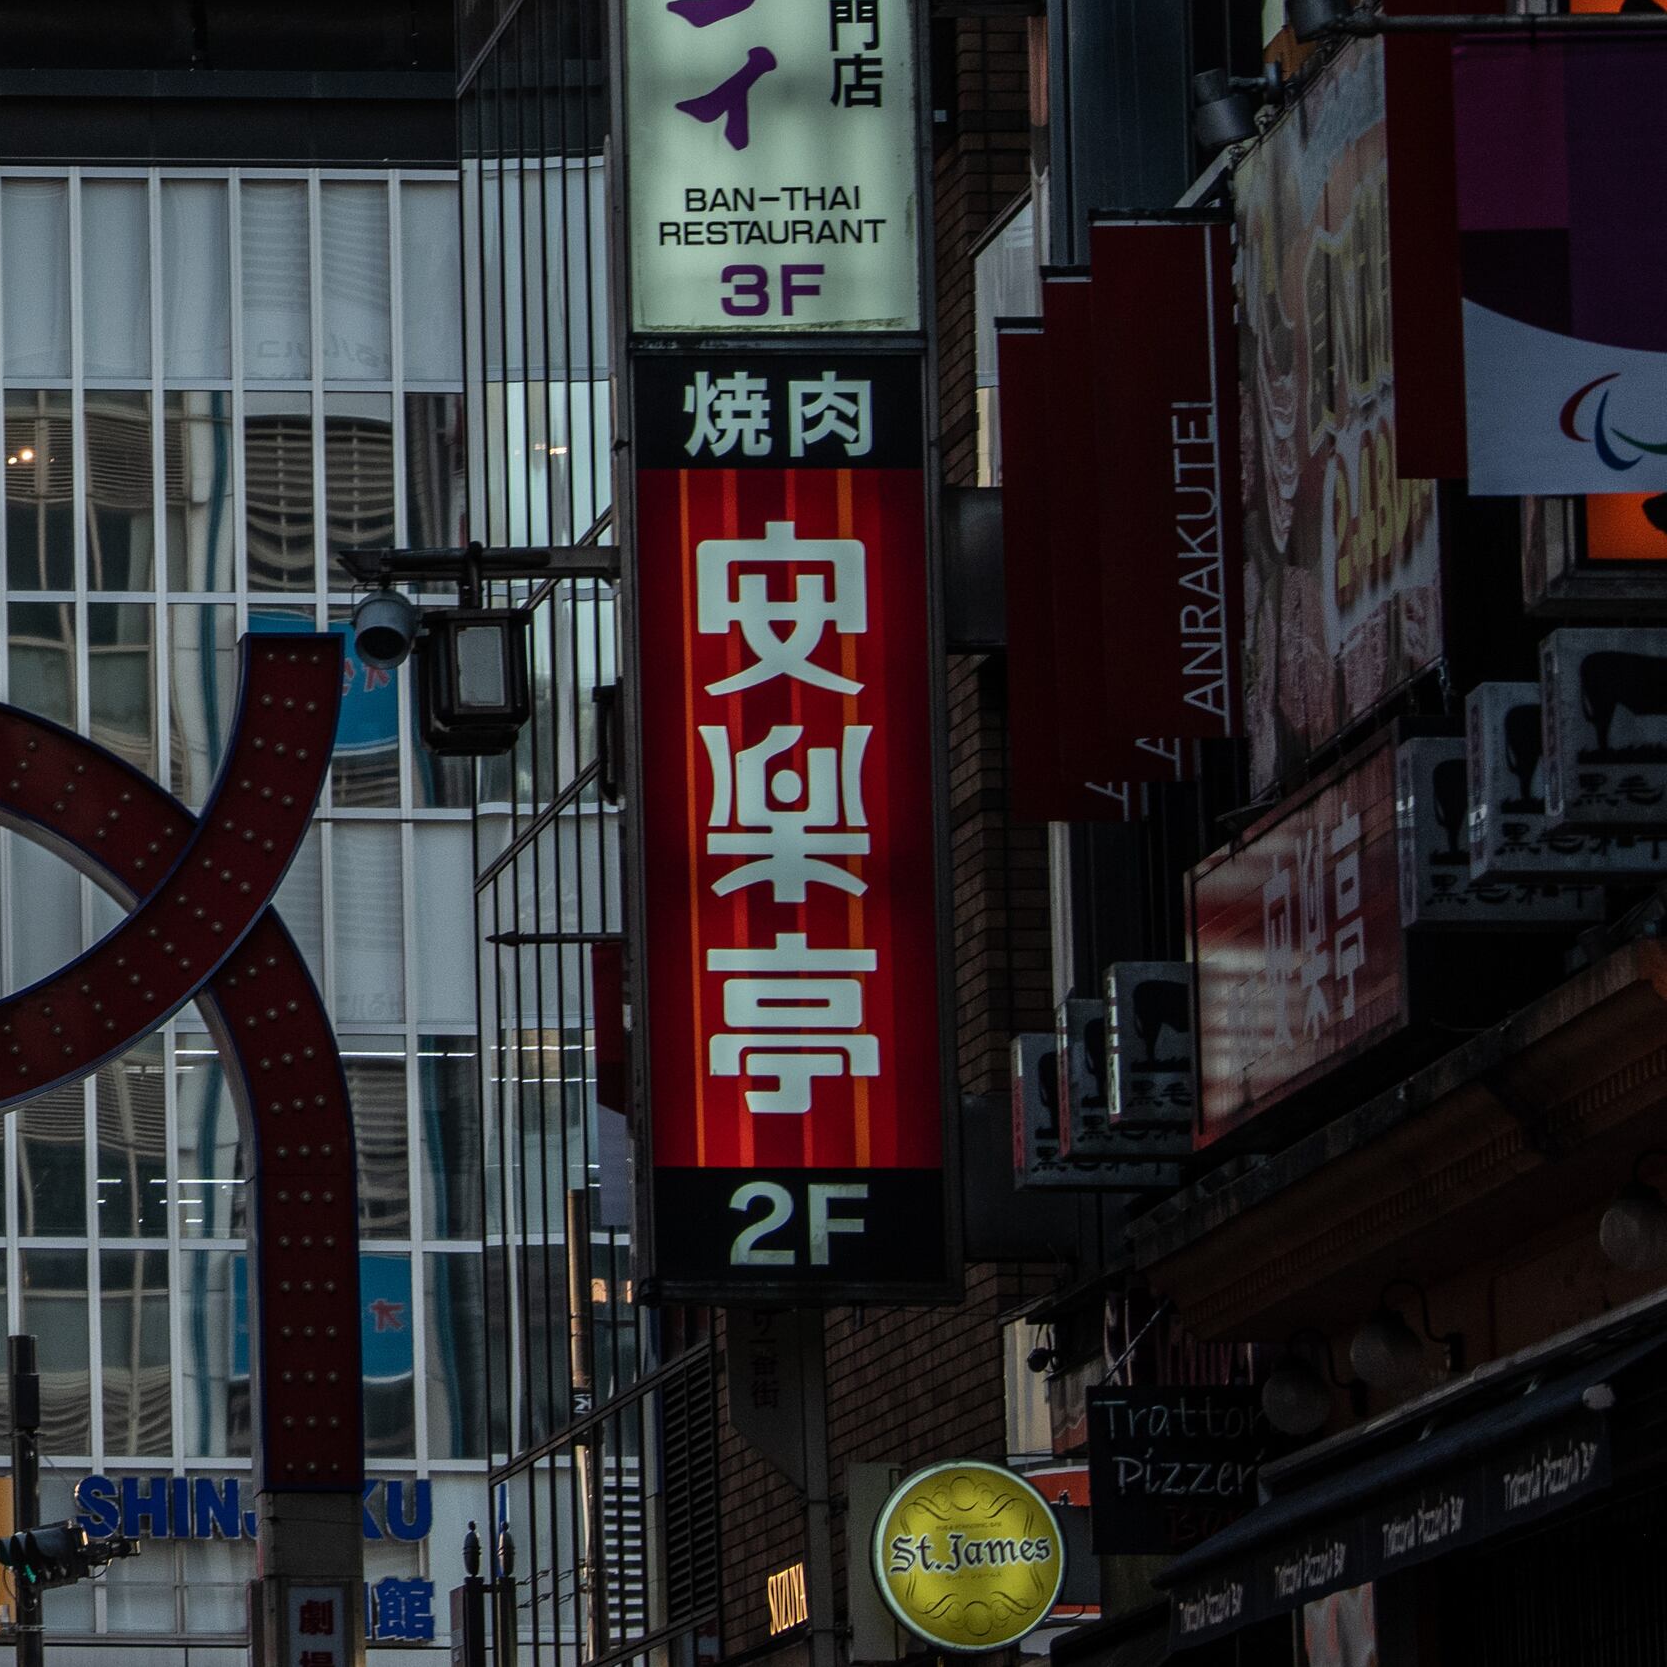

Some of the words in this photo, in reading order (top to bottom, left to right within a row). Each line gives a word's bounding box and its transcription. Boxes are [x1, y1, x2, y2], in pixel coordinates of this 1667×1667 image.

[658, 218, 887, 247] RESTAURANT
[684, 184, 862, 215] BAN-THAI
[719, 263, 828, 317] 3F
[682, 369, 876, 460] 焼肉
[1170, 399, 1229, 719] ANRAKUTEI
[694, 520, 882, 1116] 安楽亭
[727, 1181, 870, 1268] 2F
